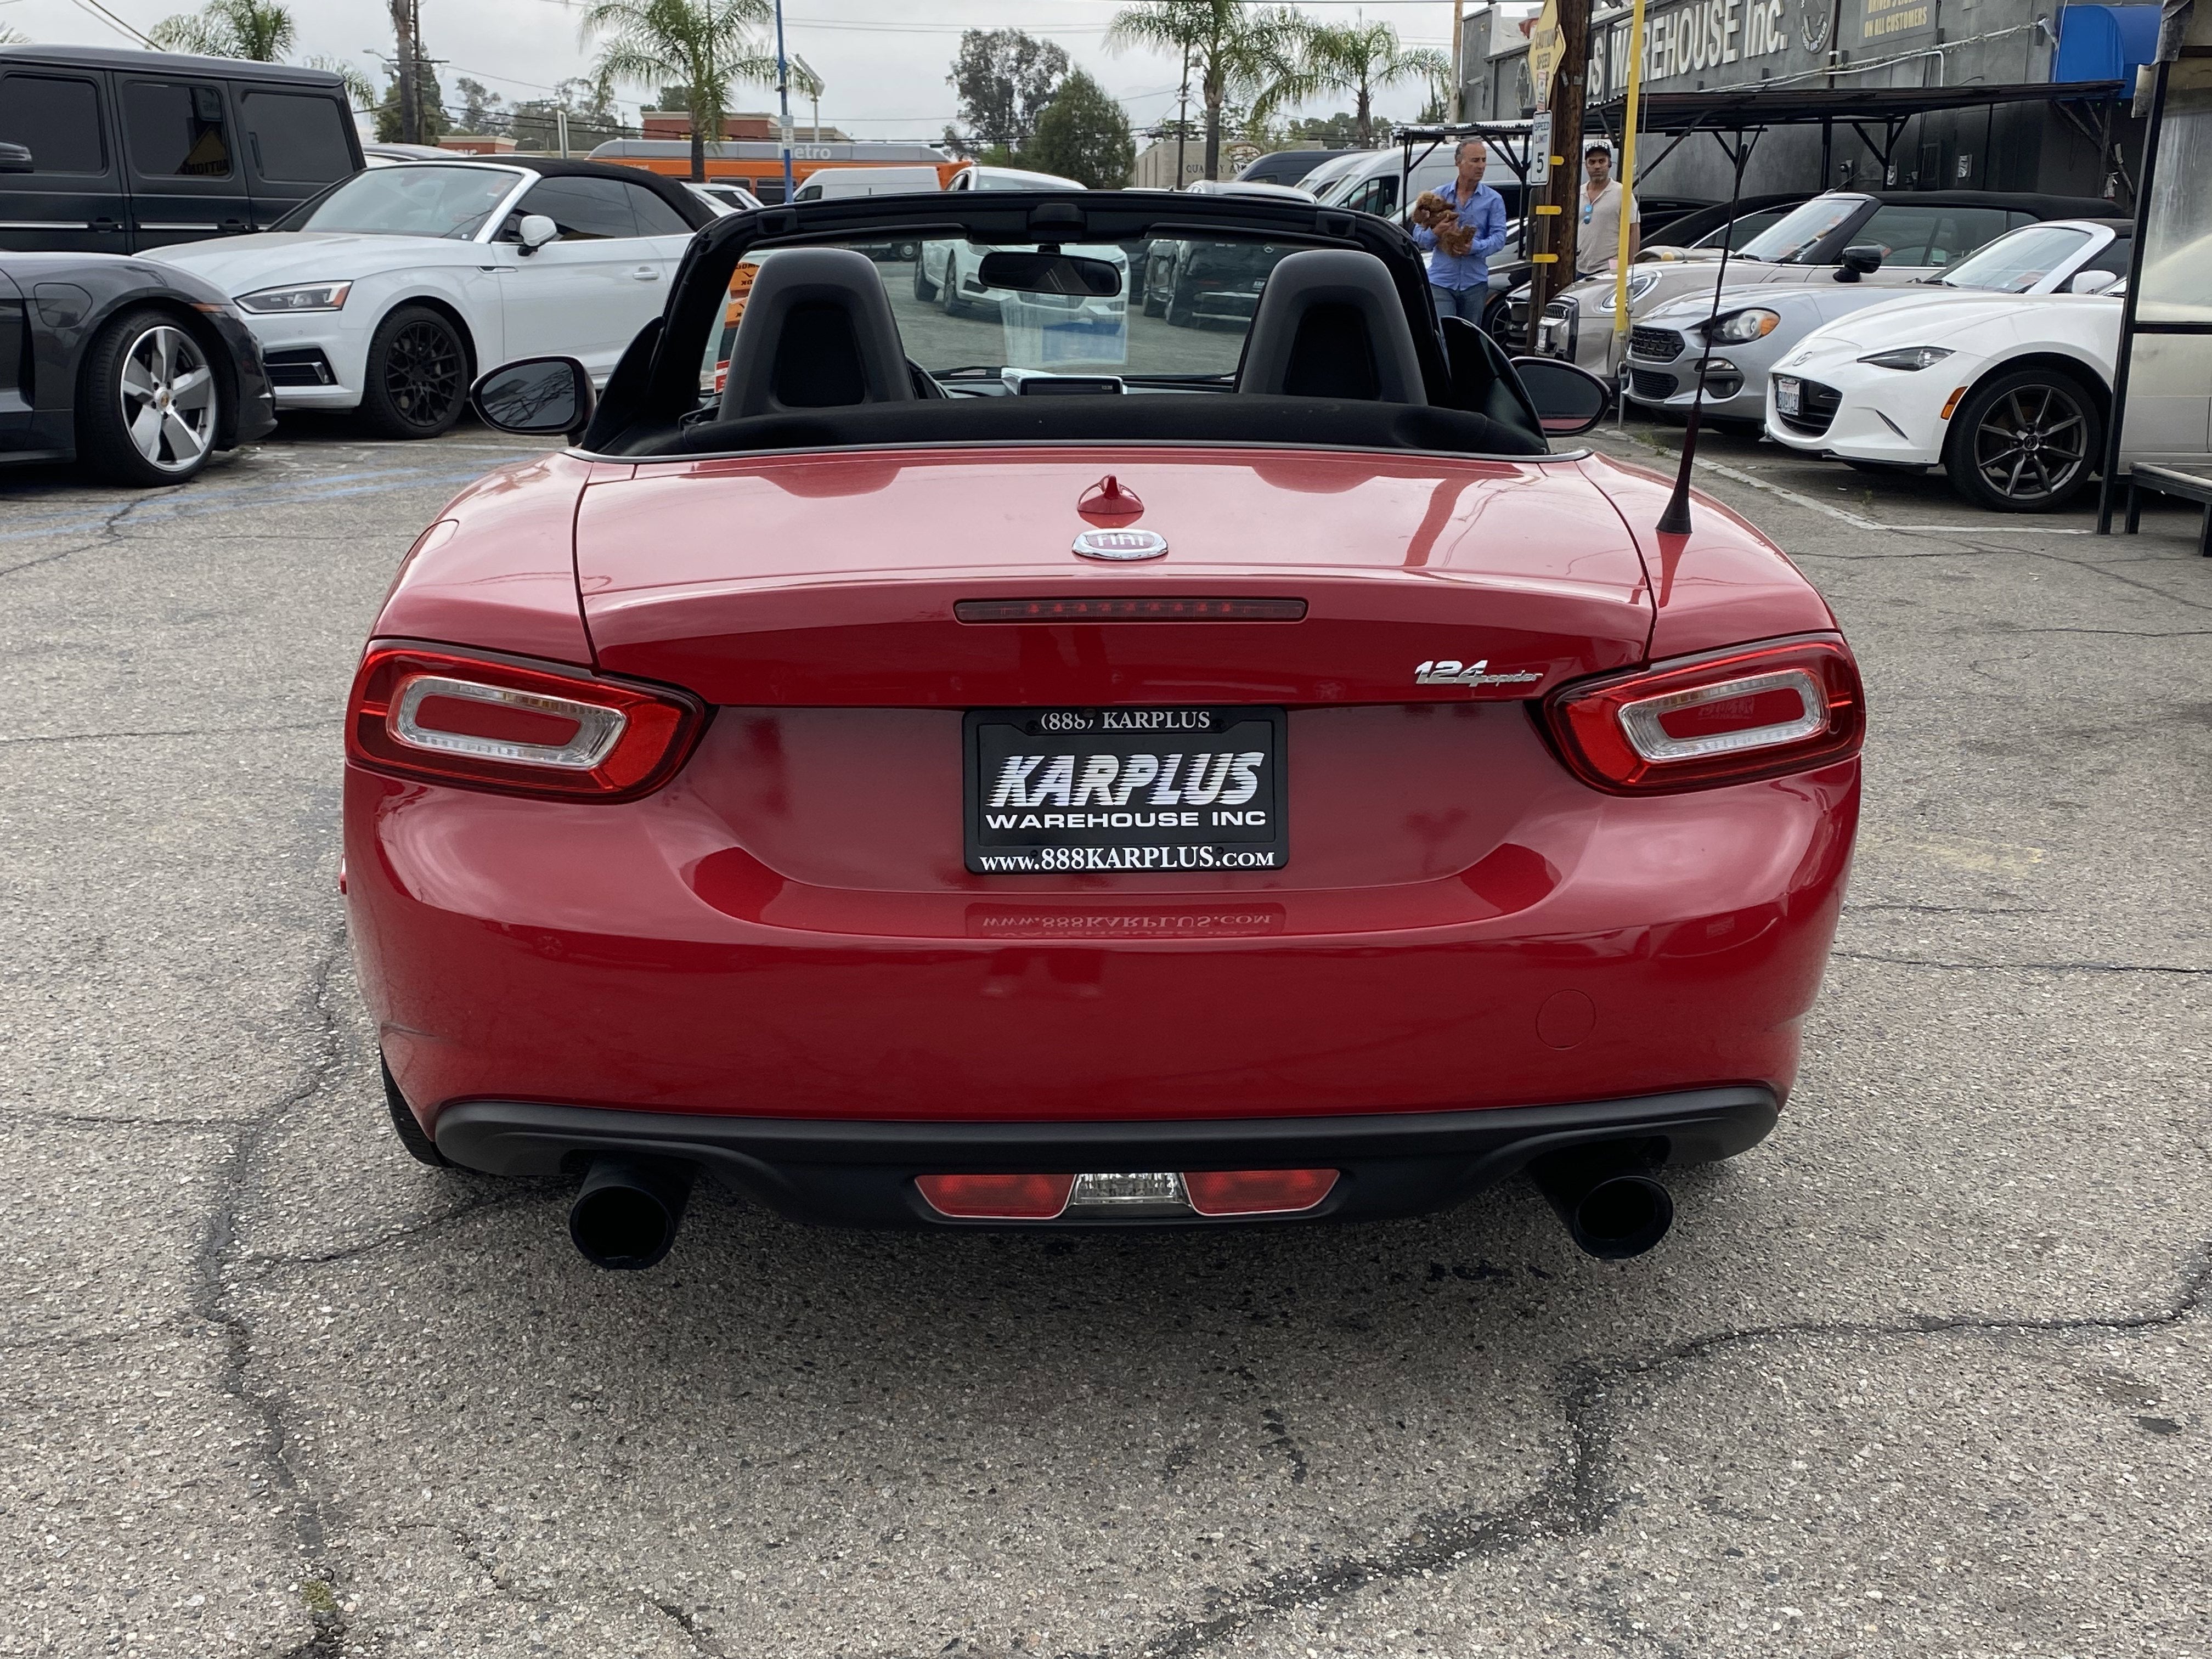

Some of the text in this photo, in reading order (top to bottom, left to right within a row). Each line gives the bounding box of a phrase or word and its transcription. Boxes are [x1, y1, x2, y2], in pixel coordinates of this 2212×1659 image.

[1744, 0, 1788, 58] Inc.
[1865, 6, 1927, 38] ON ALL CUSTOMERS
[1534, 121, 1550, 131] SPEED
[1535, 134, 1548, 144] LIMIT
[1186, 165, 1224, 174] QUAY
[1537, 152, 1544, 173] 5
[1097, 534, 1144, 546] FIAT
[1415, 660, 1487, 687] 124
[1102, 712, 1210, 729] KARPLUS
[986, 752, 1265, 806] KARPLUS
[986, 811, 1266, 828] WAREHOUSE INC
